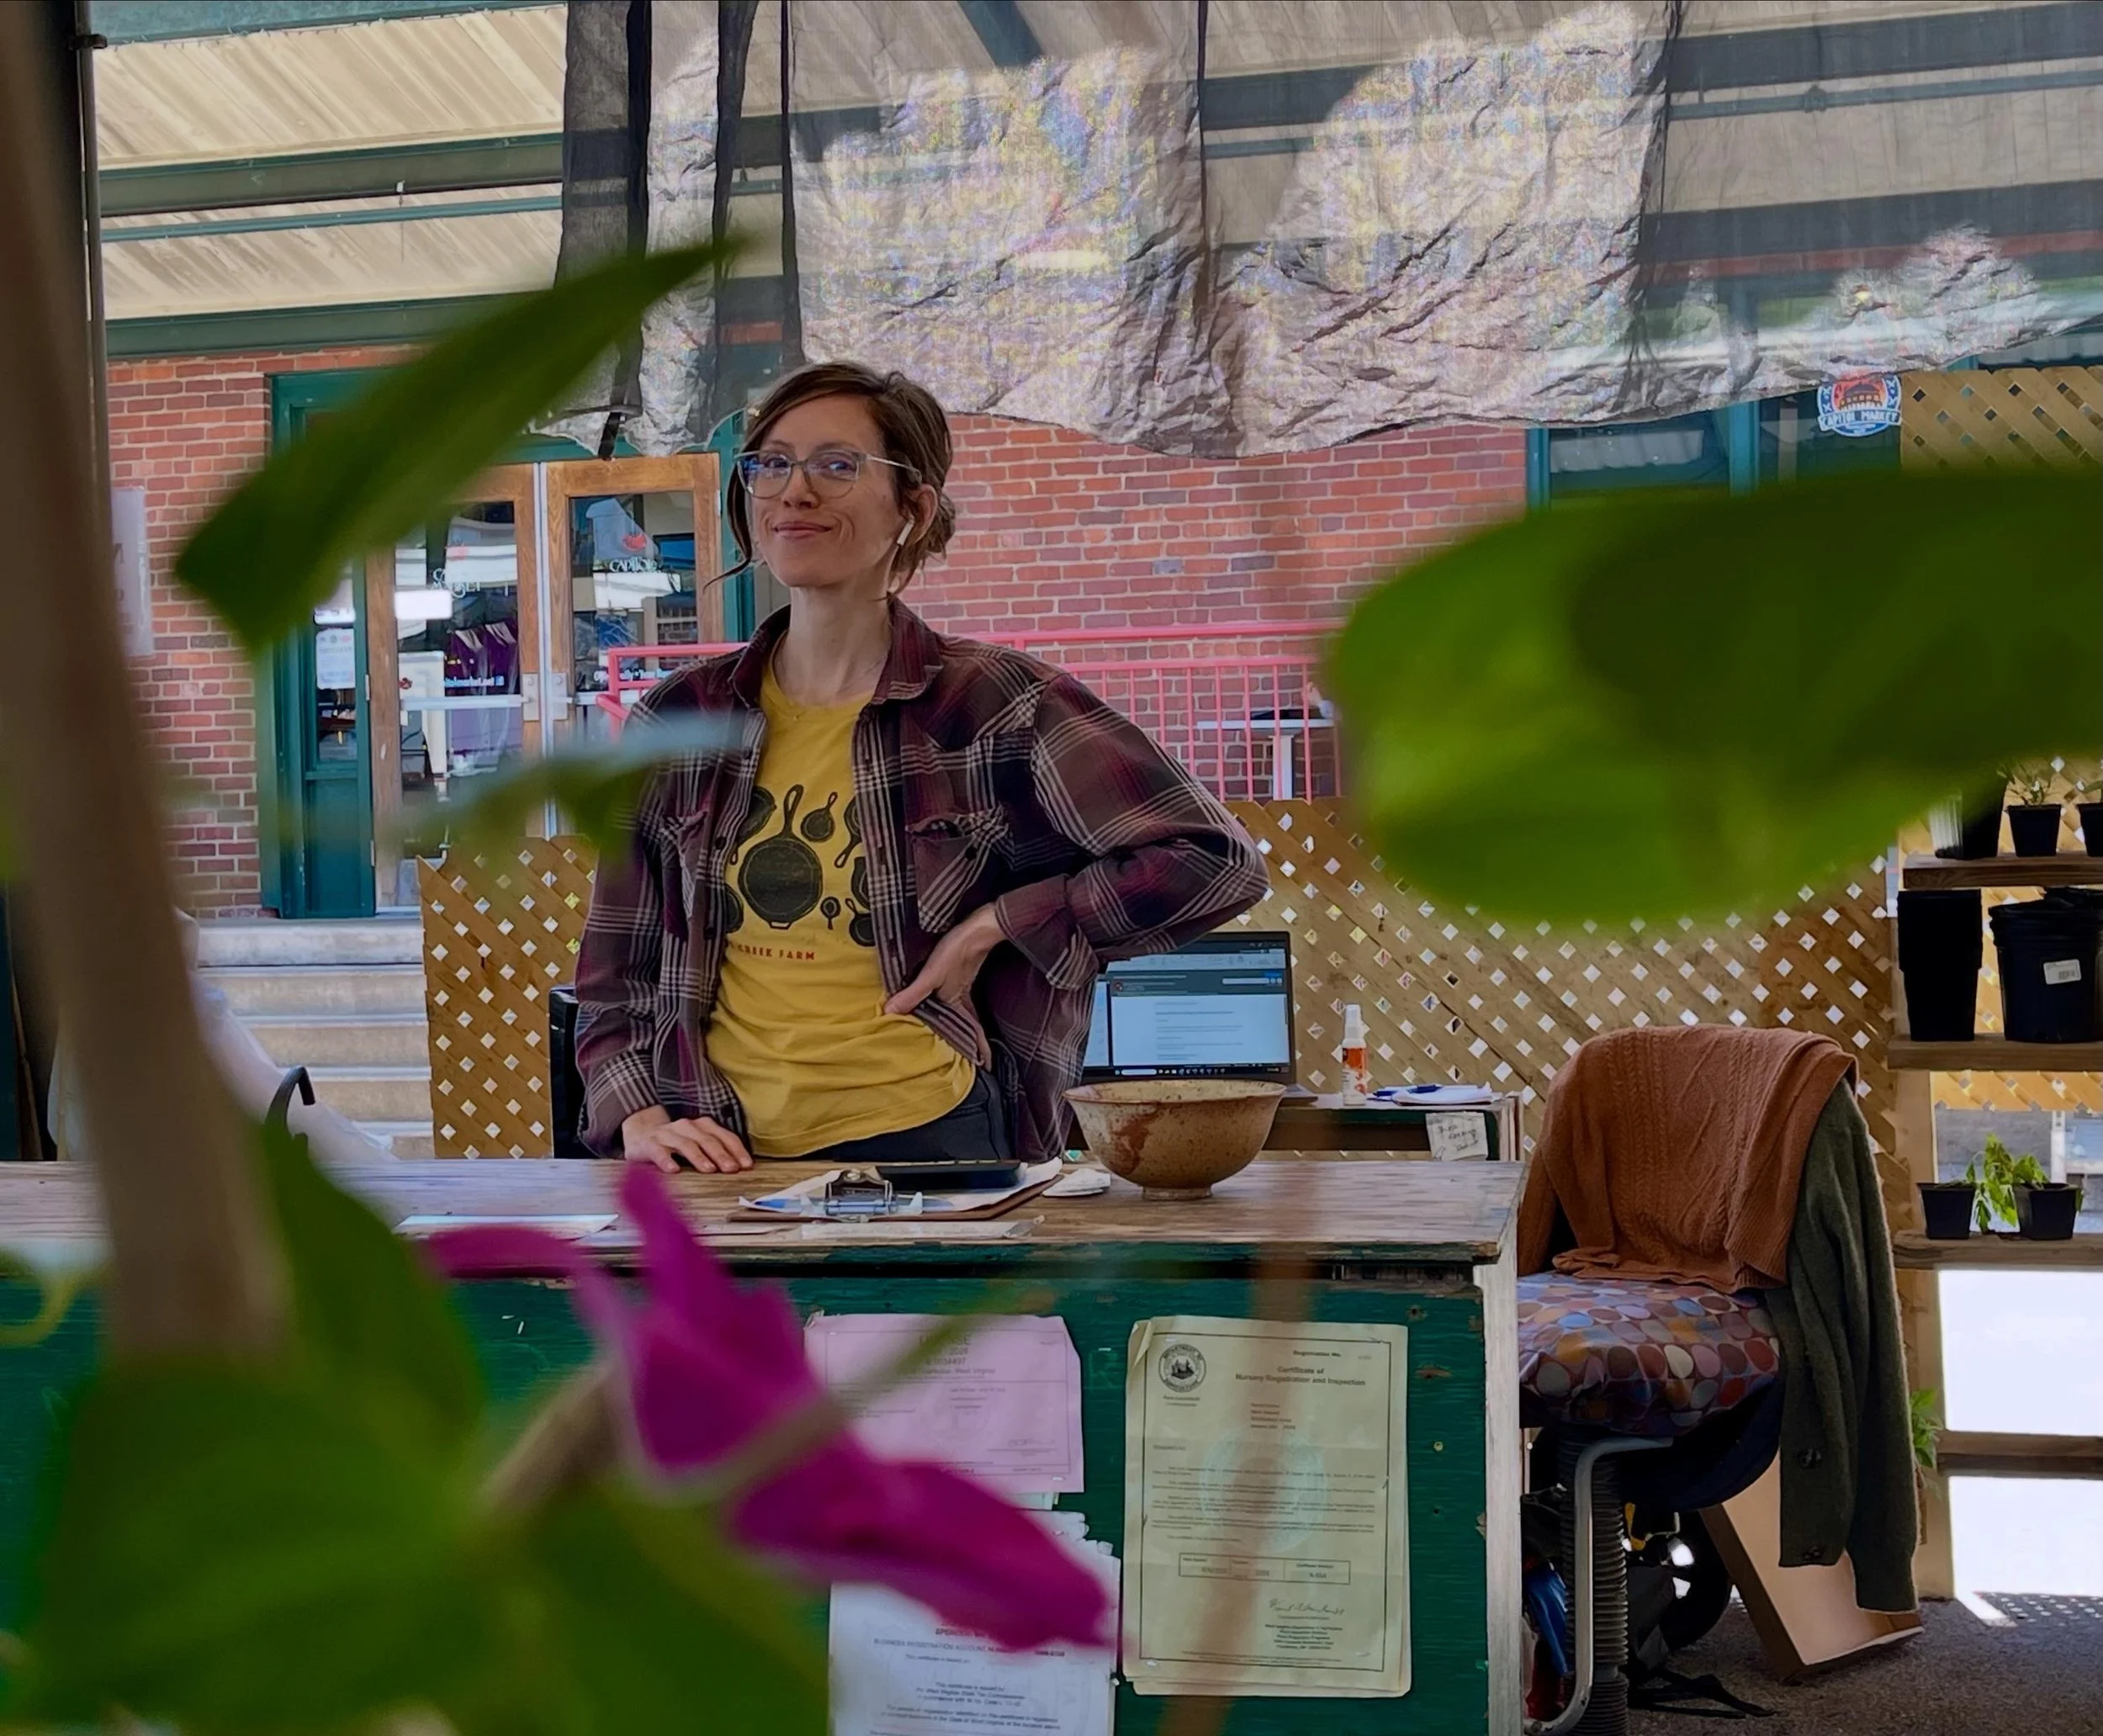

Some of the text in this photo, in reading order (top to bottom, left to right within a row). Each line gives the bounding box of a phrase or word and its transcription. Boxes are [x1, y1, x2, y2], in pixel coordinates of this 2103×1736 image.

[1821, 410, 1898, 426] CAPITOL MARKET
[779, 949, 815, 960] FARM
[1277, 1365, 1315, 1374] Certificate
[1235, 1373, 1264, 1383] Nursery
[1265, 1374, 1311, 1384] Registration
[1327, 1378, 1366, 1387] Inspection
